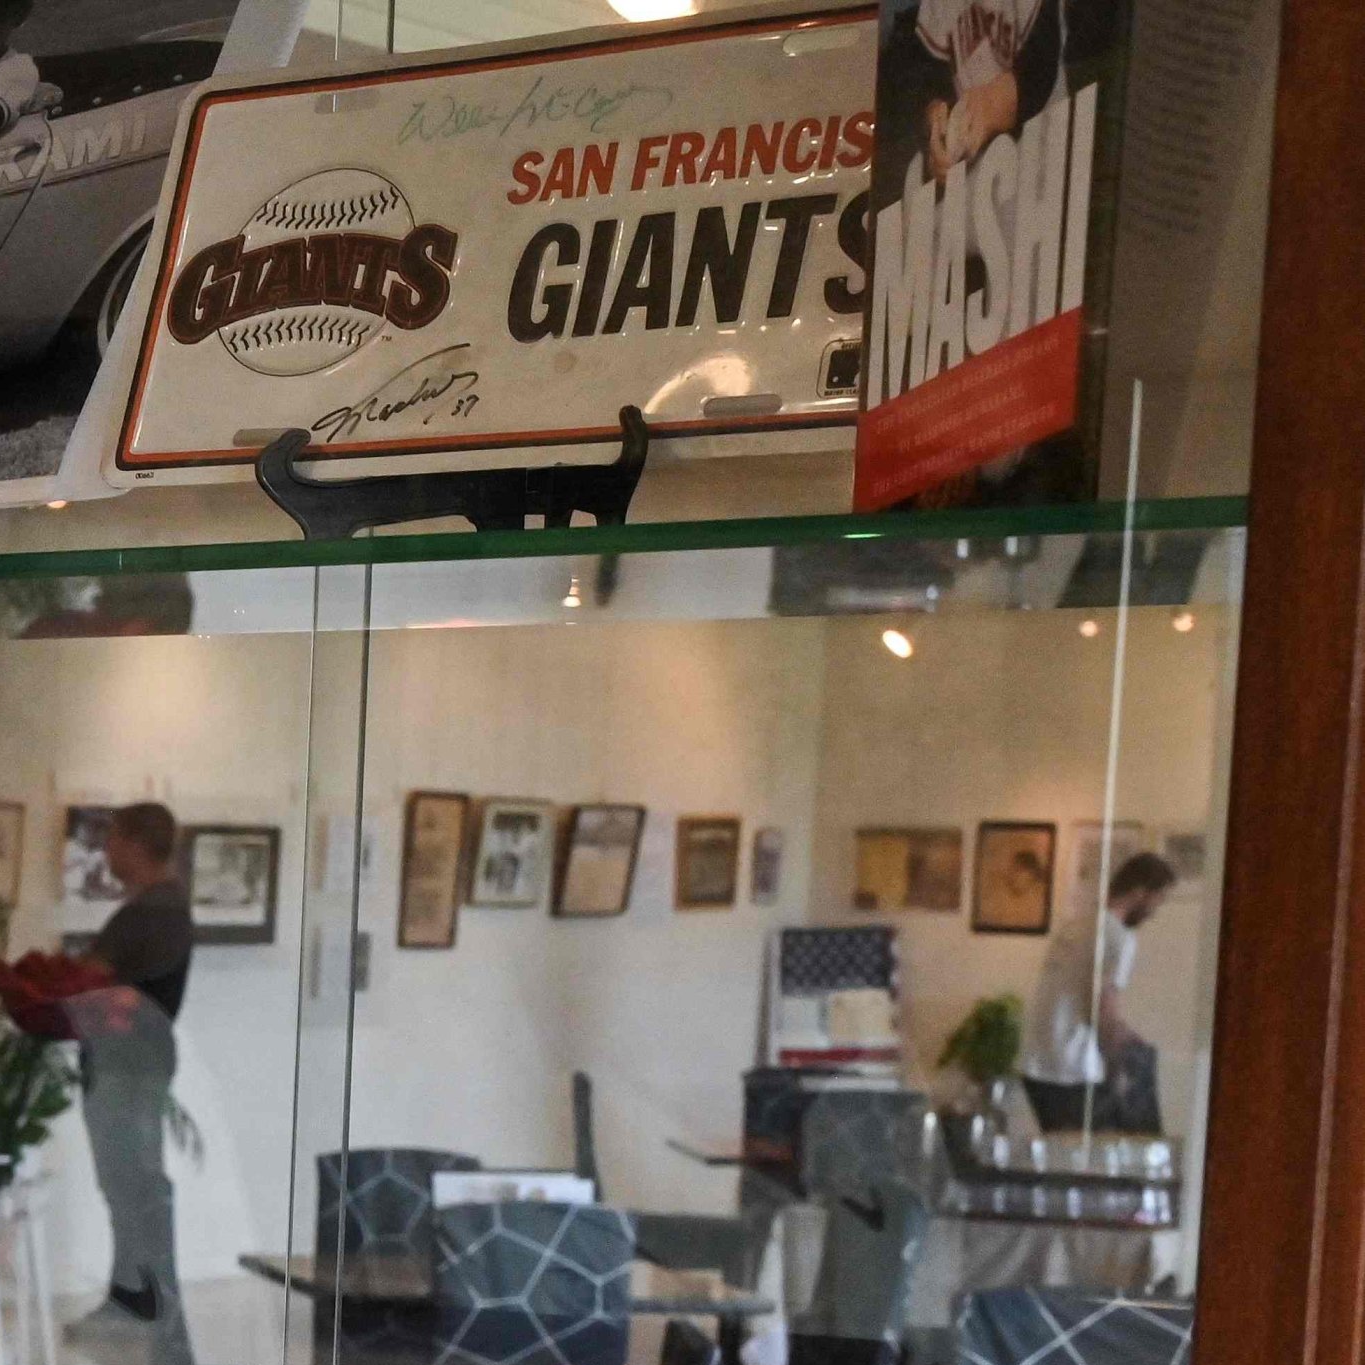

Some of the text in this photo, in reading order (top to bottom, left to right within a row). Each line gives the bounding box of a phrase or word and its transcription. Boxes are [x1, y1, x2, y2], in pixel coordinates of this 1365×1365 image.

[506, 111, 877, 205] SAN FRANCIS
[167, 223, 459, 345] GIANTS
[507, 189, 872, 344] GIANTS
[867, 82, 1098, 411] MASHI
